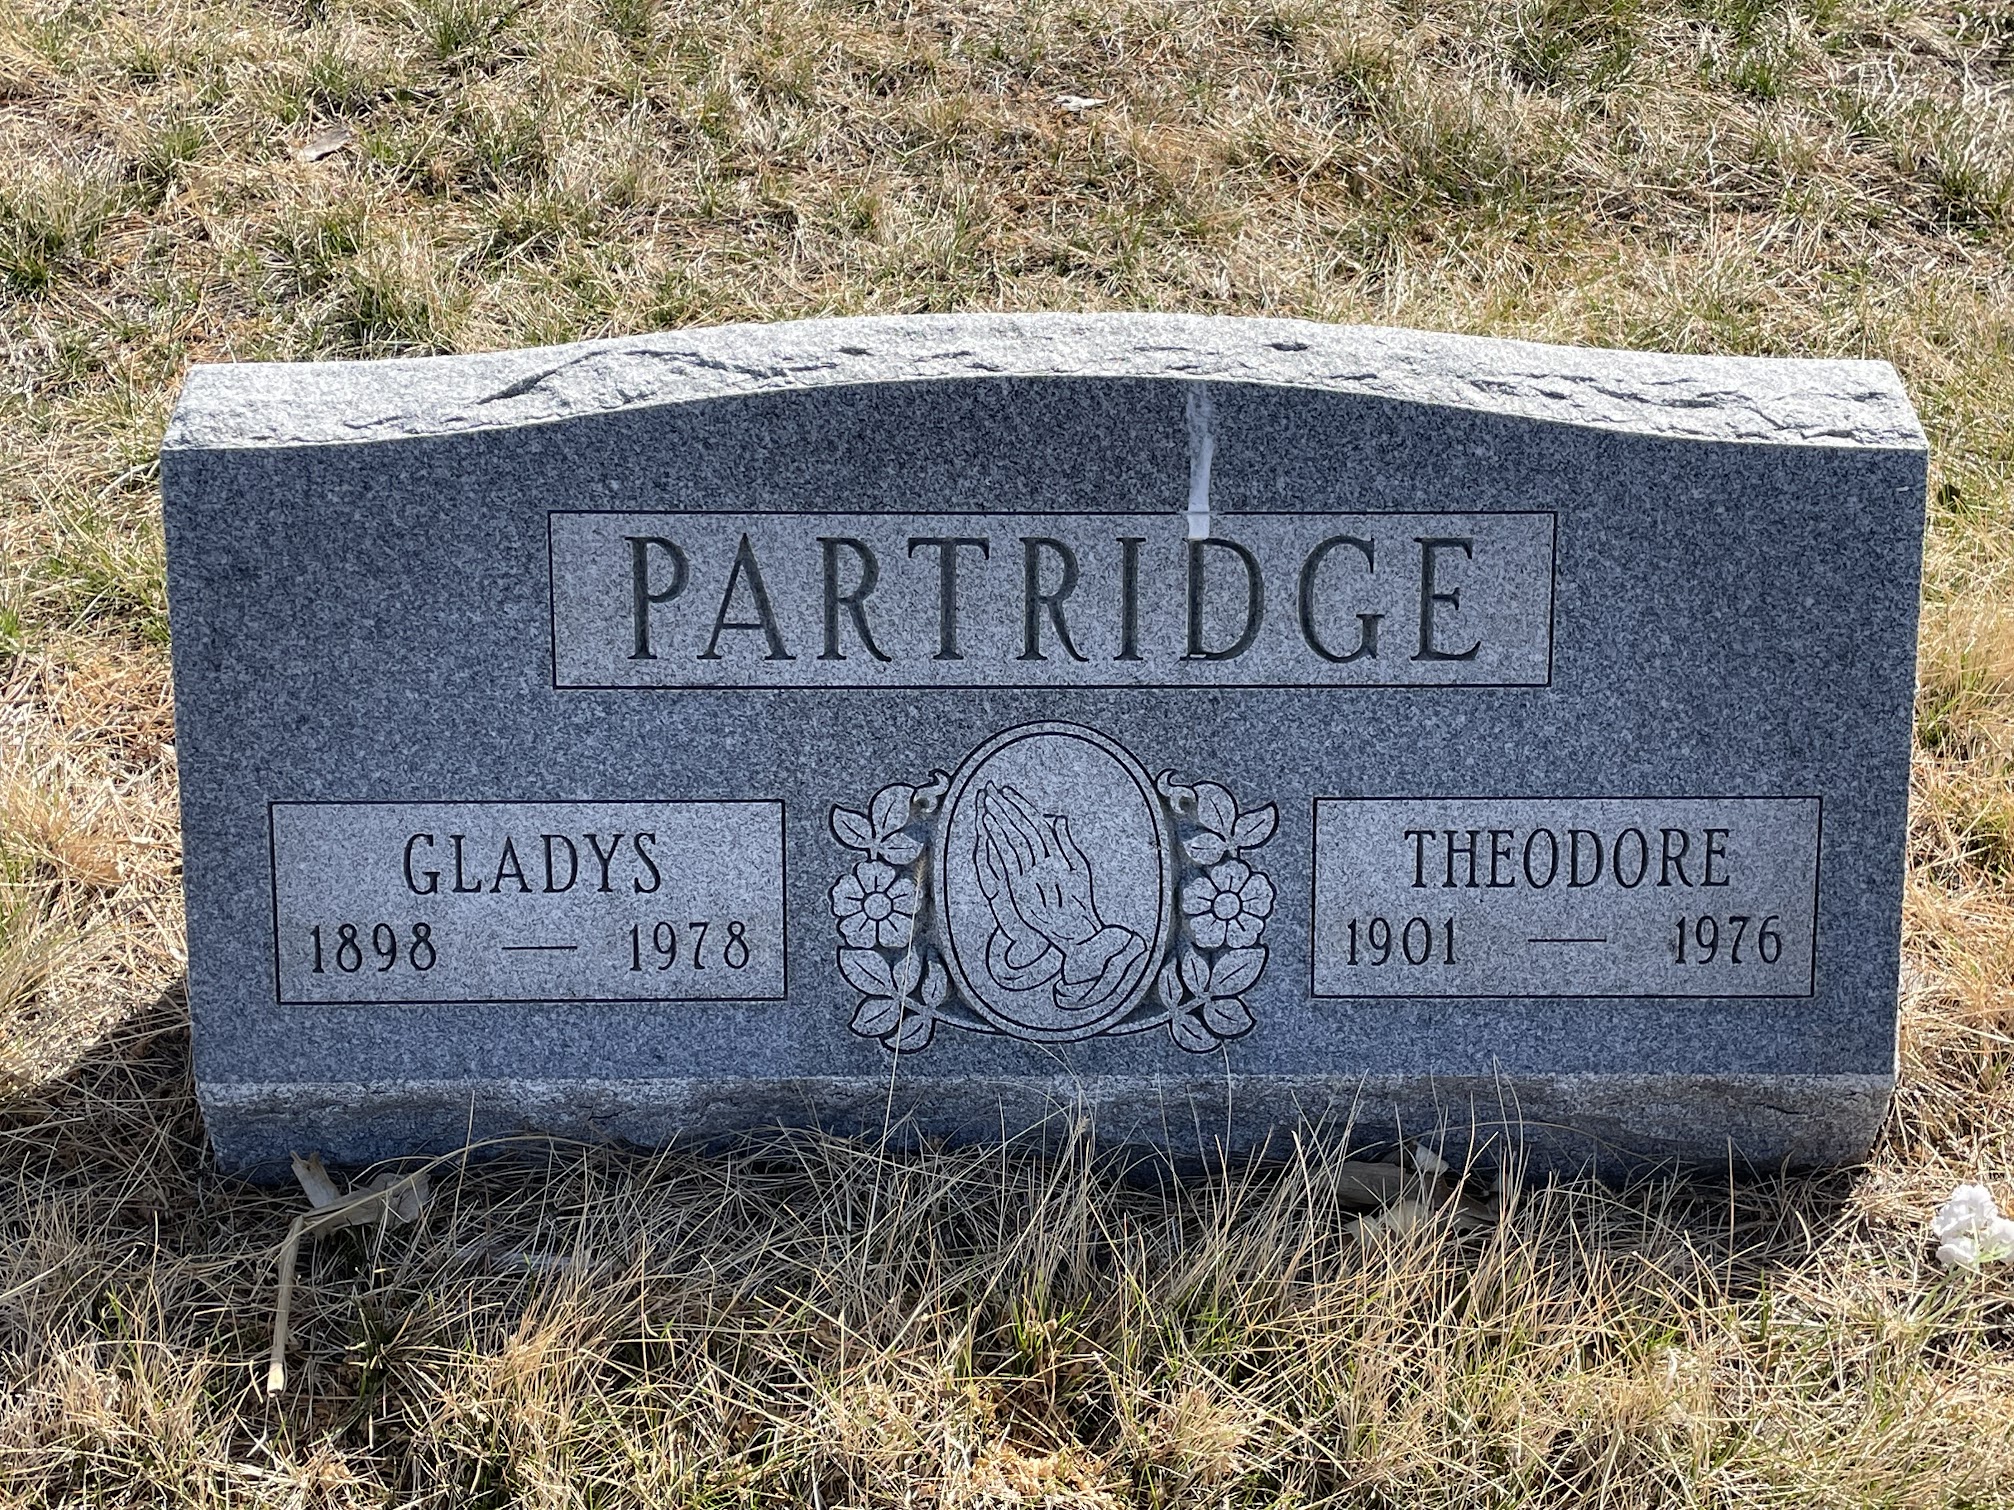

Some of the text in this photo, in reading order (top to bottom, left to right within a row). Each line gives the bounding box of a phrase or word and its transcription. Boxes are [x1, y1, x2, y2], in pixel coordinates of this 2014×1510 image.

[622, 532, 1482, 663] PARTRIDGE
[403, 833, 661, 895] GLADYS
[1404, 829, 1731, 889] THEODORE
[311, 922, 437, 973] 1898
[628, 921, 751, 972] 1978
[1346, 918, 1459, 966] 1901
[1673, 915, 1783, 964] 1976
